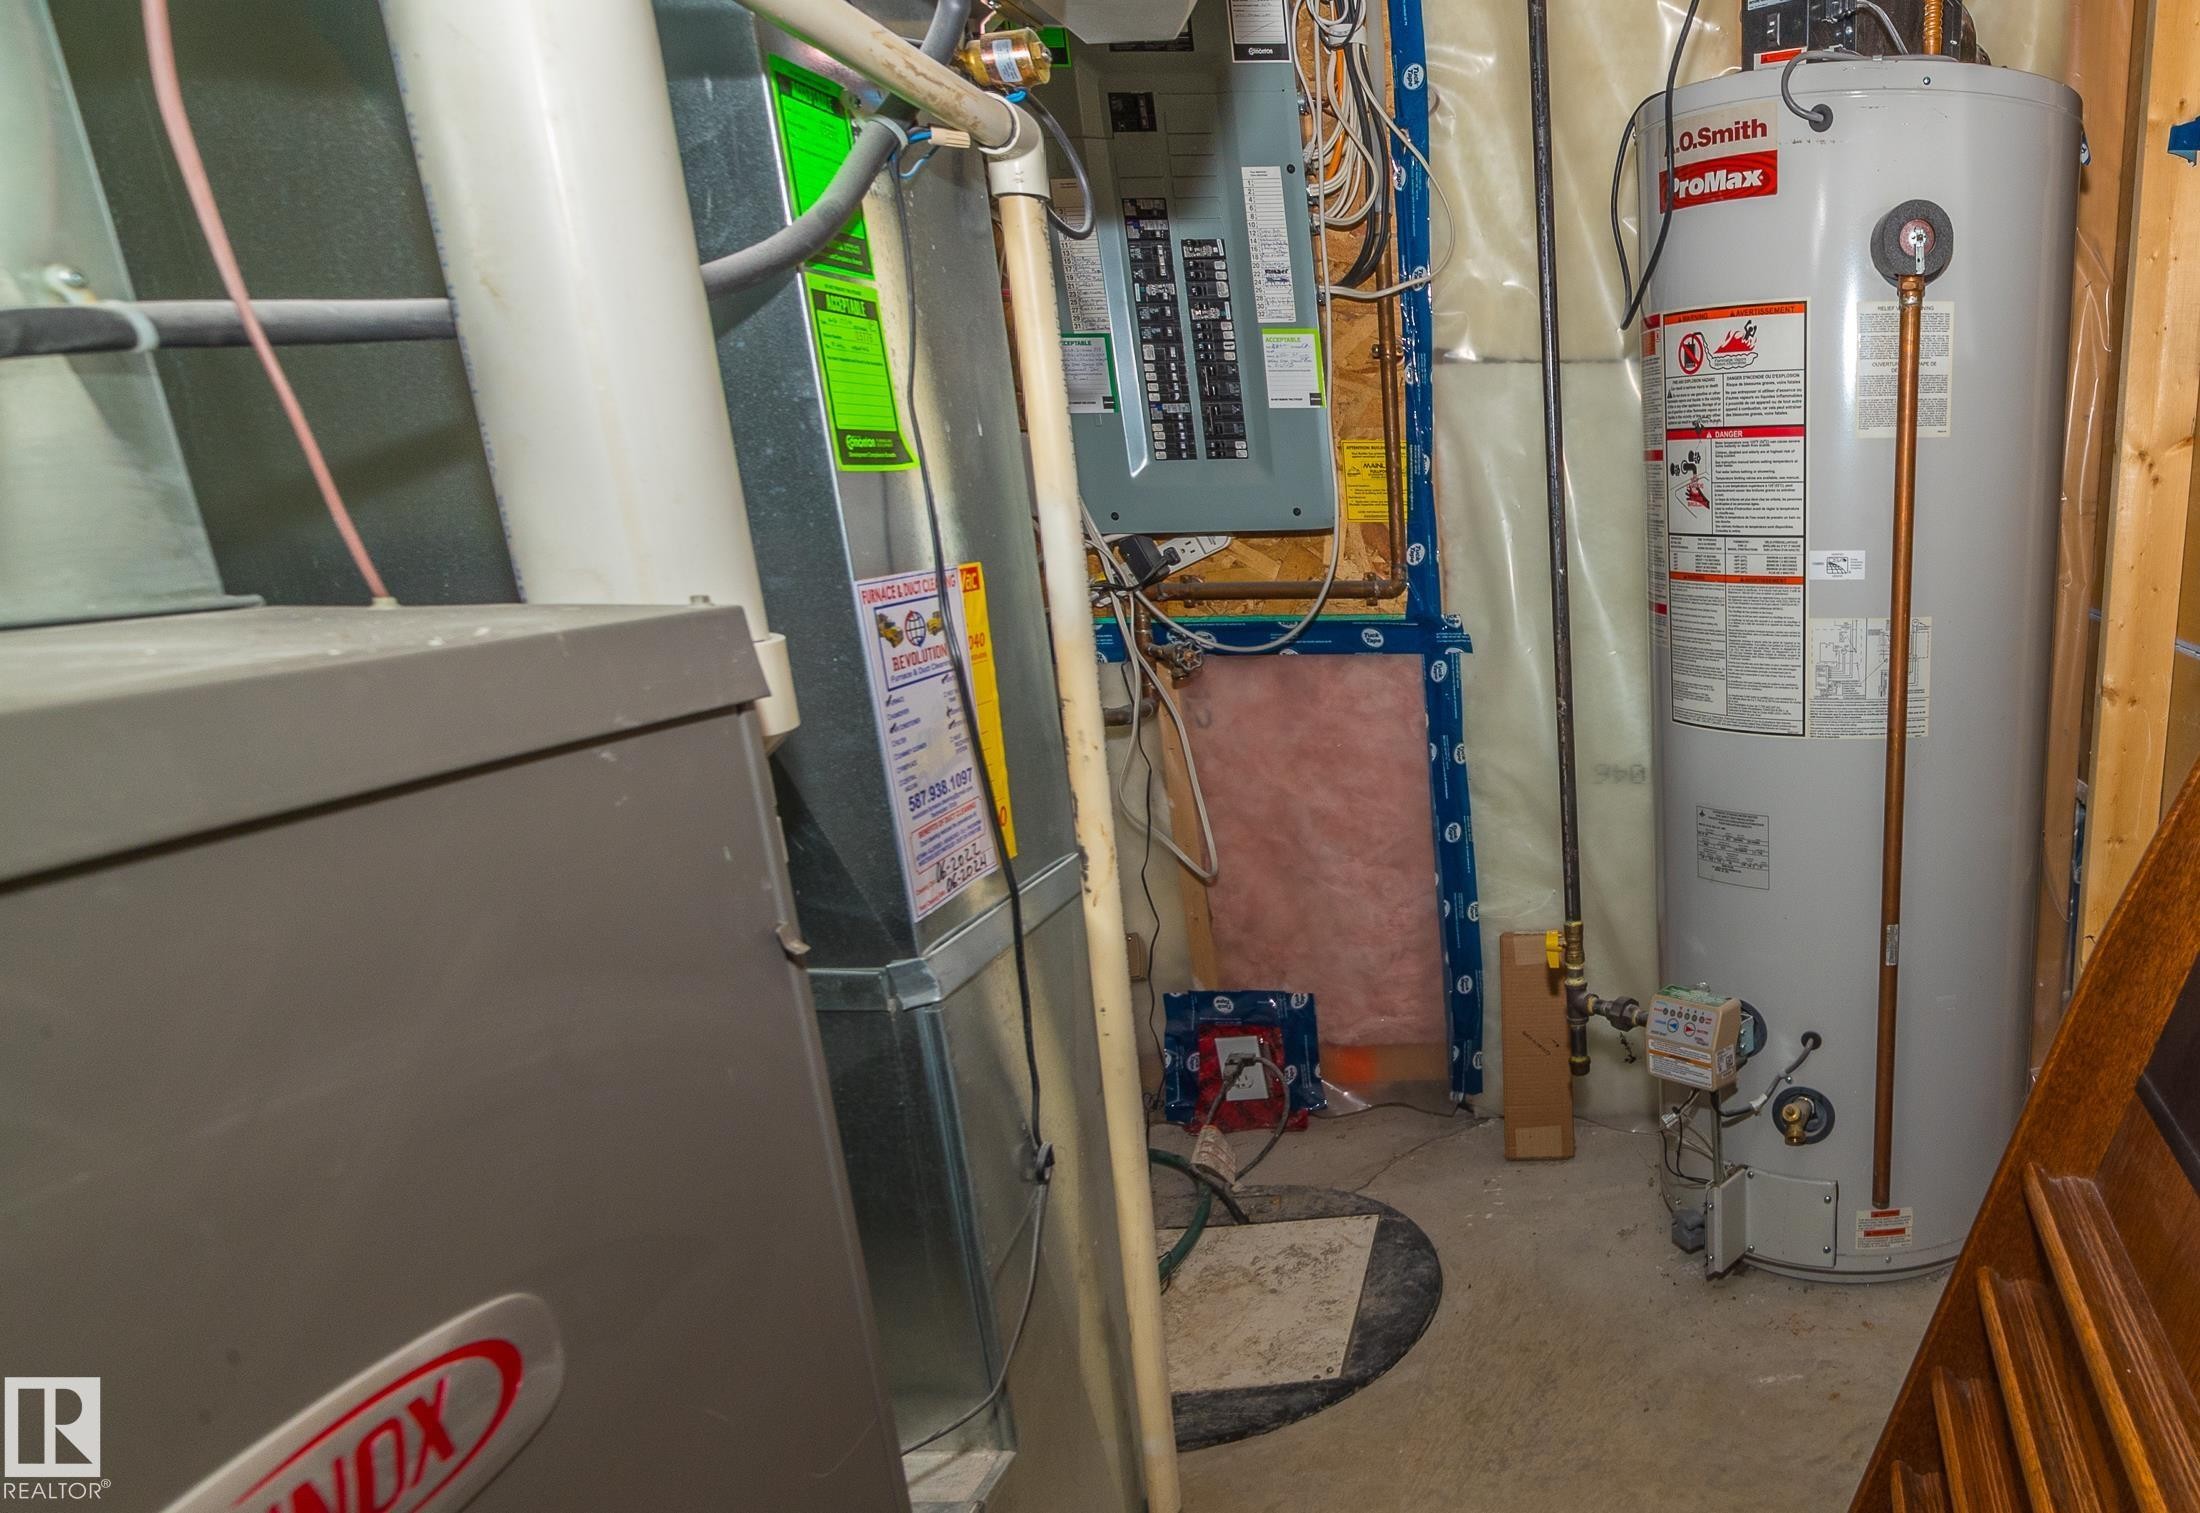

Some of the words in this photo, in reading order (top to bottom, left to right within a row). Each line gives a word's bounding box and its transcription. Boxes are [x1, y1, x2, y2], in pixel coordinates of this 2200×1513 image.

[1664, 119, 1768, 157] .O.Smith
[1736, 306, 1795, 317] AVERTISSEMENT
[908, 767, 972, 812] 587.938.1097
